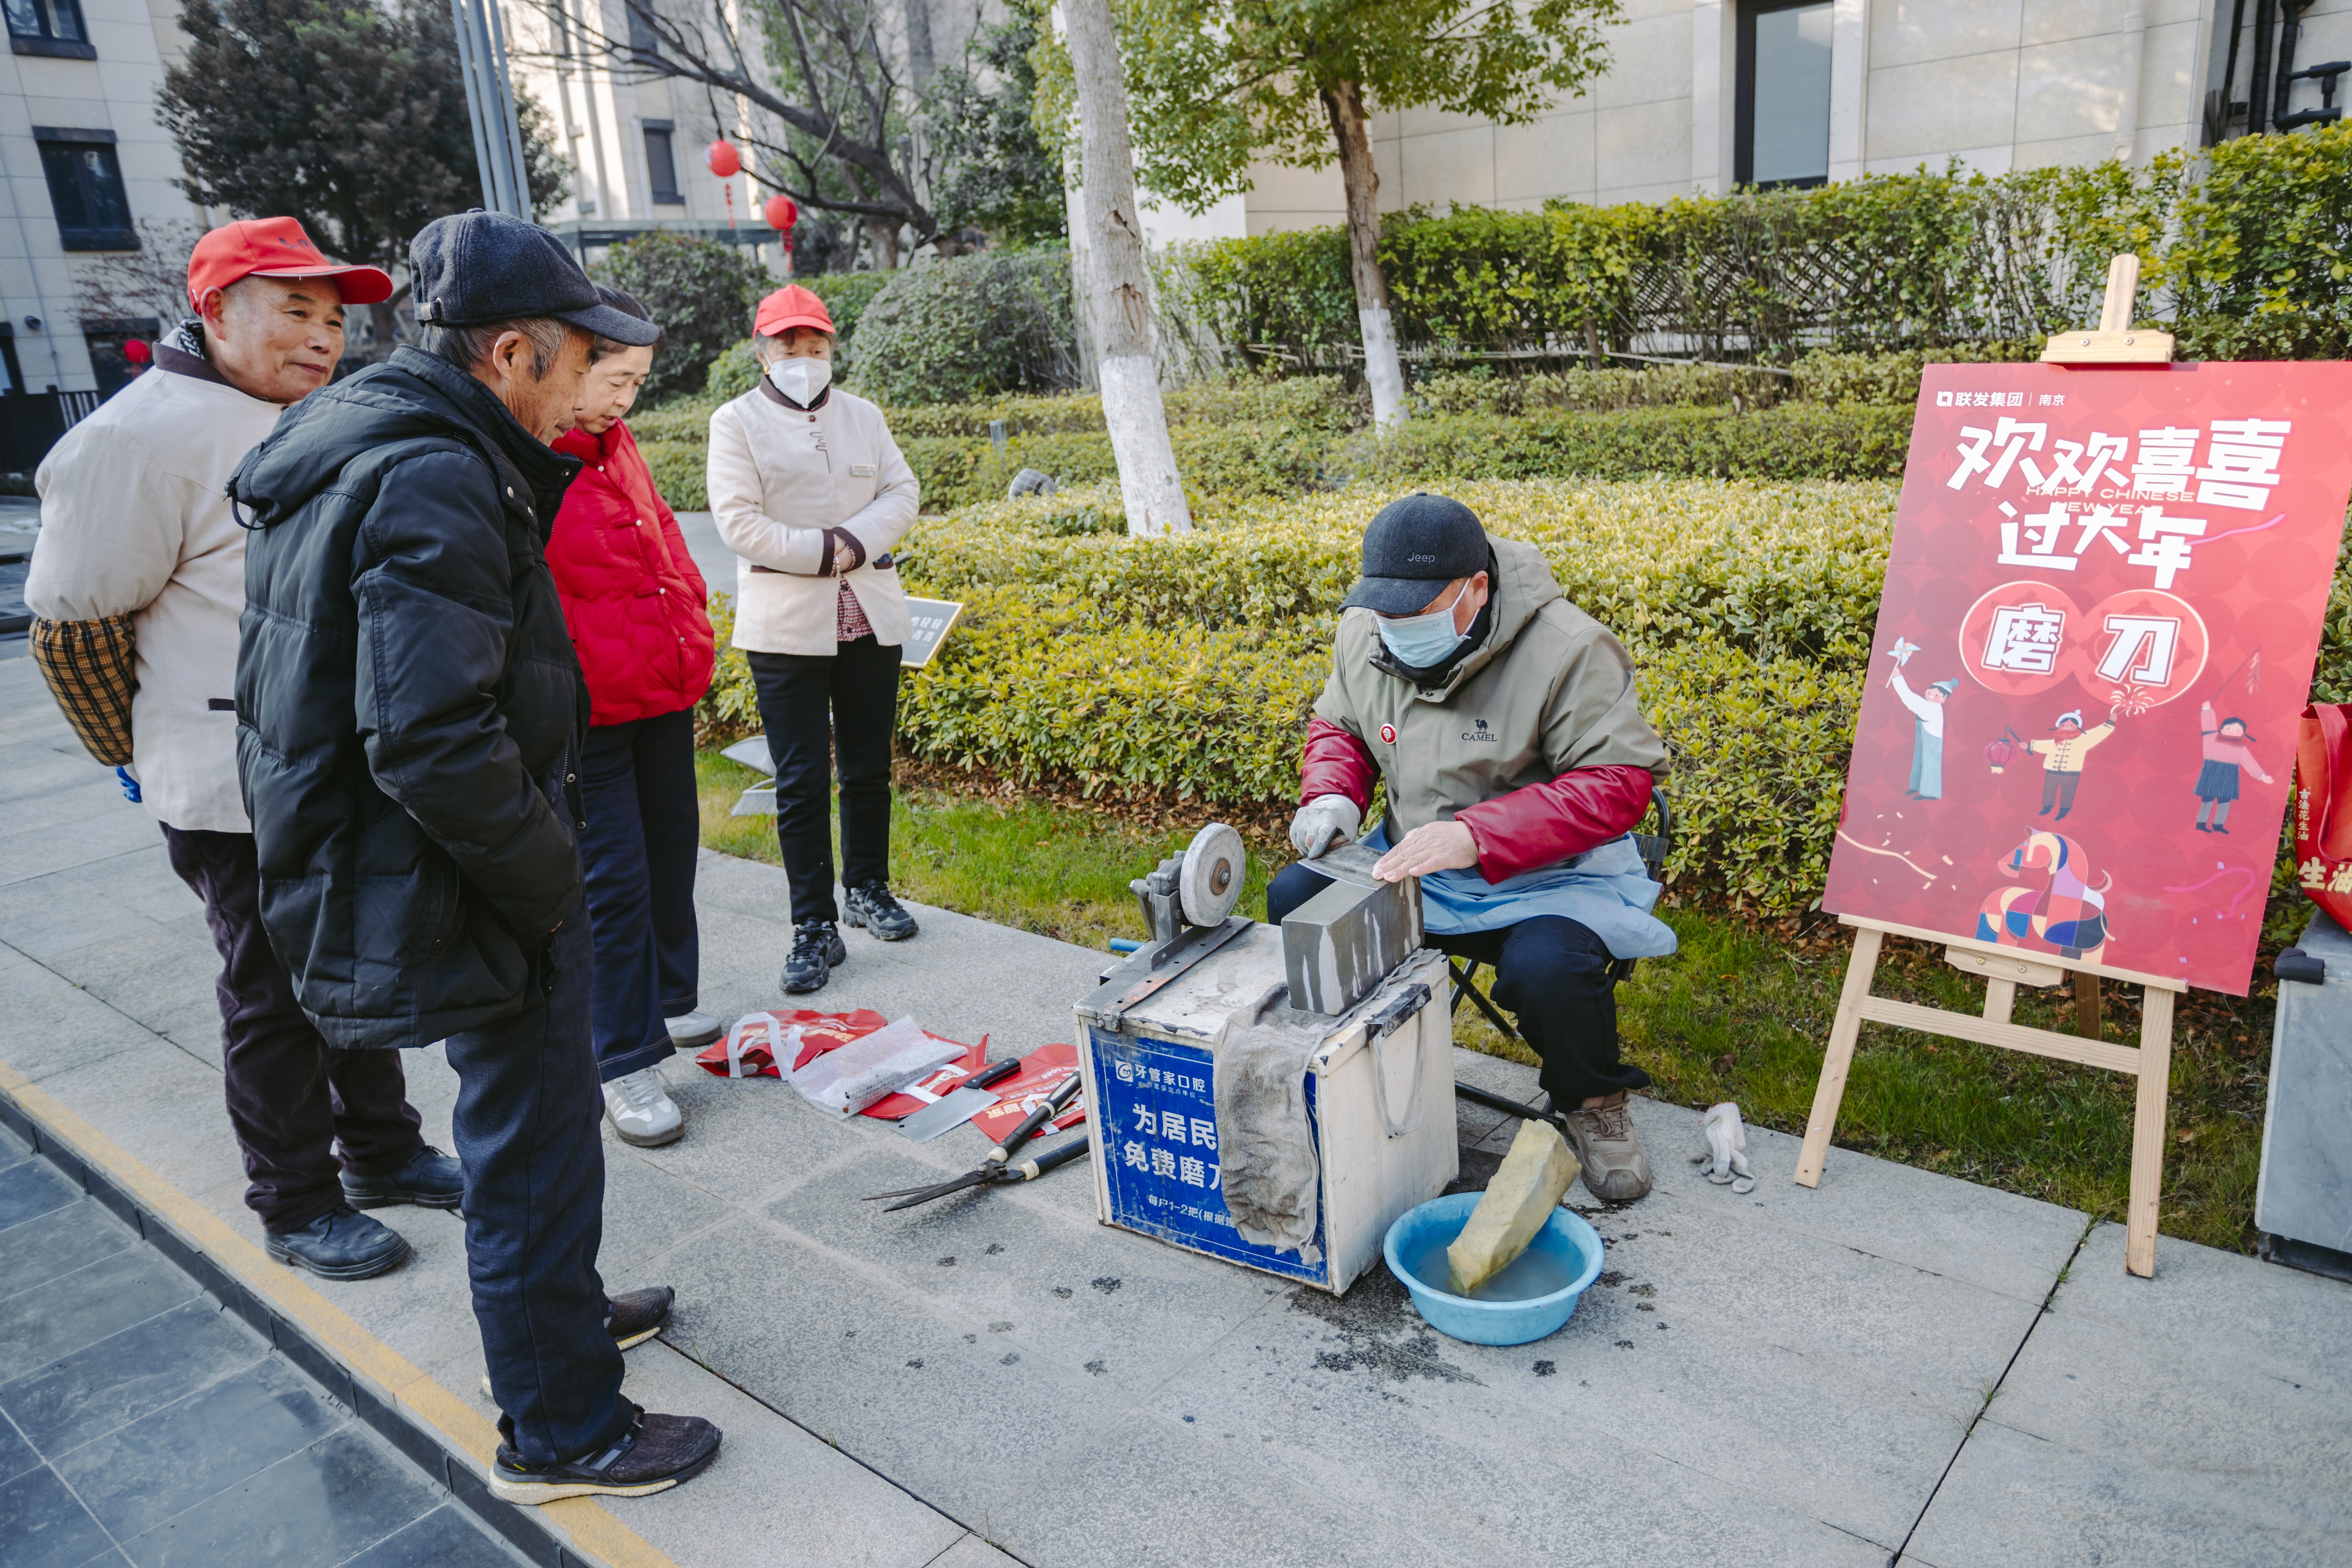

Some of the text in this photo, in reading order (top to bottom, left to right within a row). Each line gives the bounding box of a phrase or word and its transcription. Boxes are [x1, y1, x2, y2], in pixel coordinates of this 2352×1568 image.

[1955, 391, 2066, 407] 联发集团 南京
[1946, 416, 2292, 511] 欢欢喜喜
[2026, 486, 2195, 502] HAPPY CHINESE
[2054, 501, 2164, 515] NEW YEAR
[1407, 552, 1436, 565] Jeep
[1997, 500, 2208, 590] 过大年
[1983, 603, 2180, 685] 磨刀
[1461, 733, 1497, 742] CAMEL
[2297, 788, 2311, 841] 古法花生油
[2298, 856, 2352, 894] 生油
[1135, 1064, 1206, 1093] 牙管家口腔
[1132, 1103, 1217, 1150] 为居民
